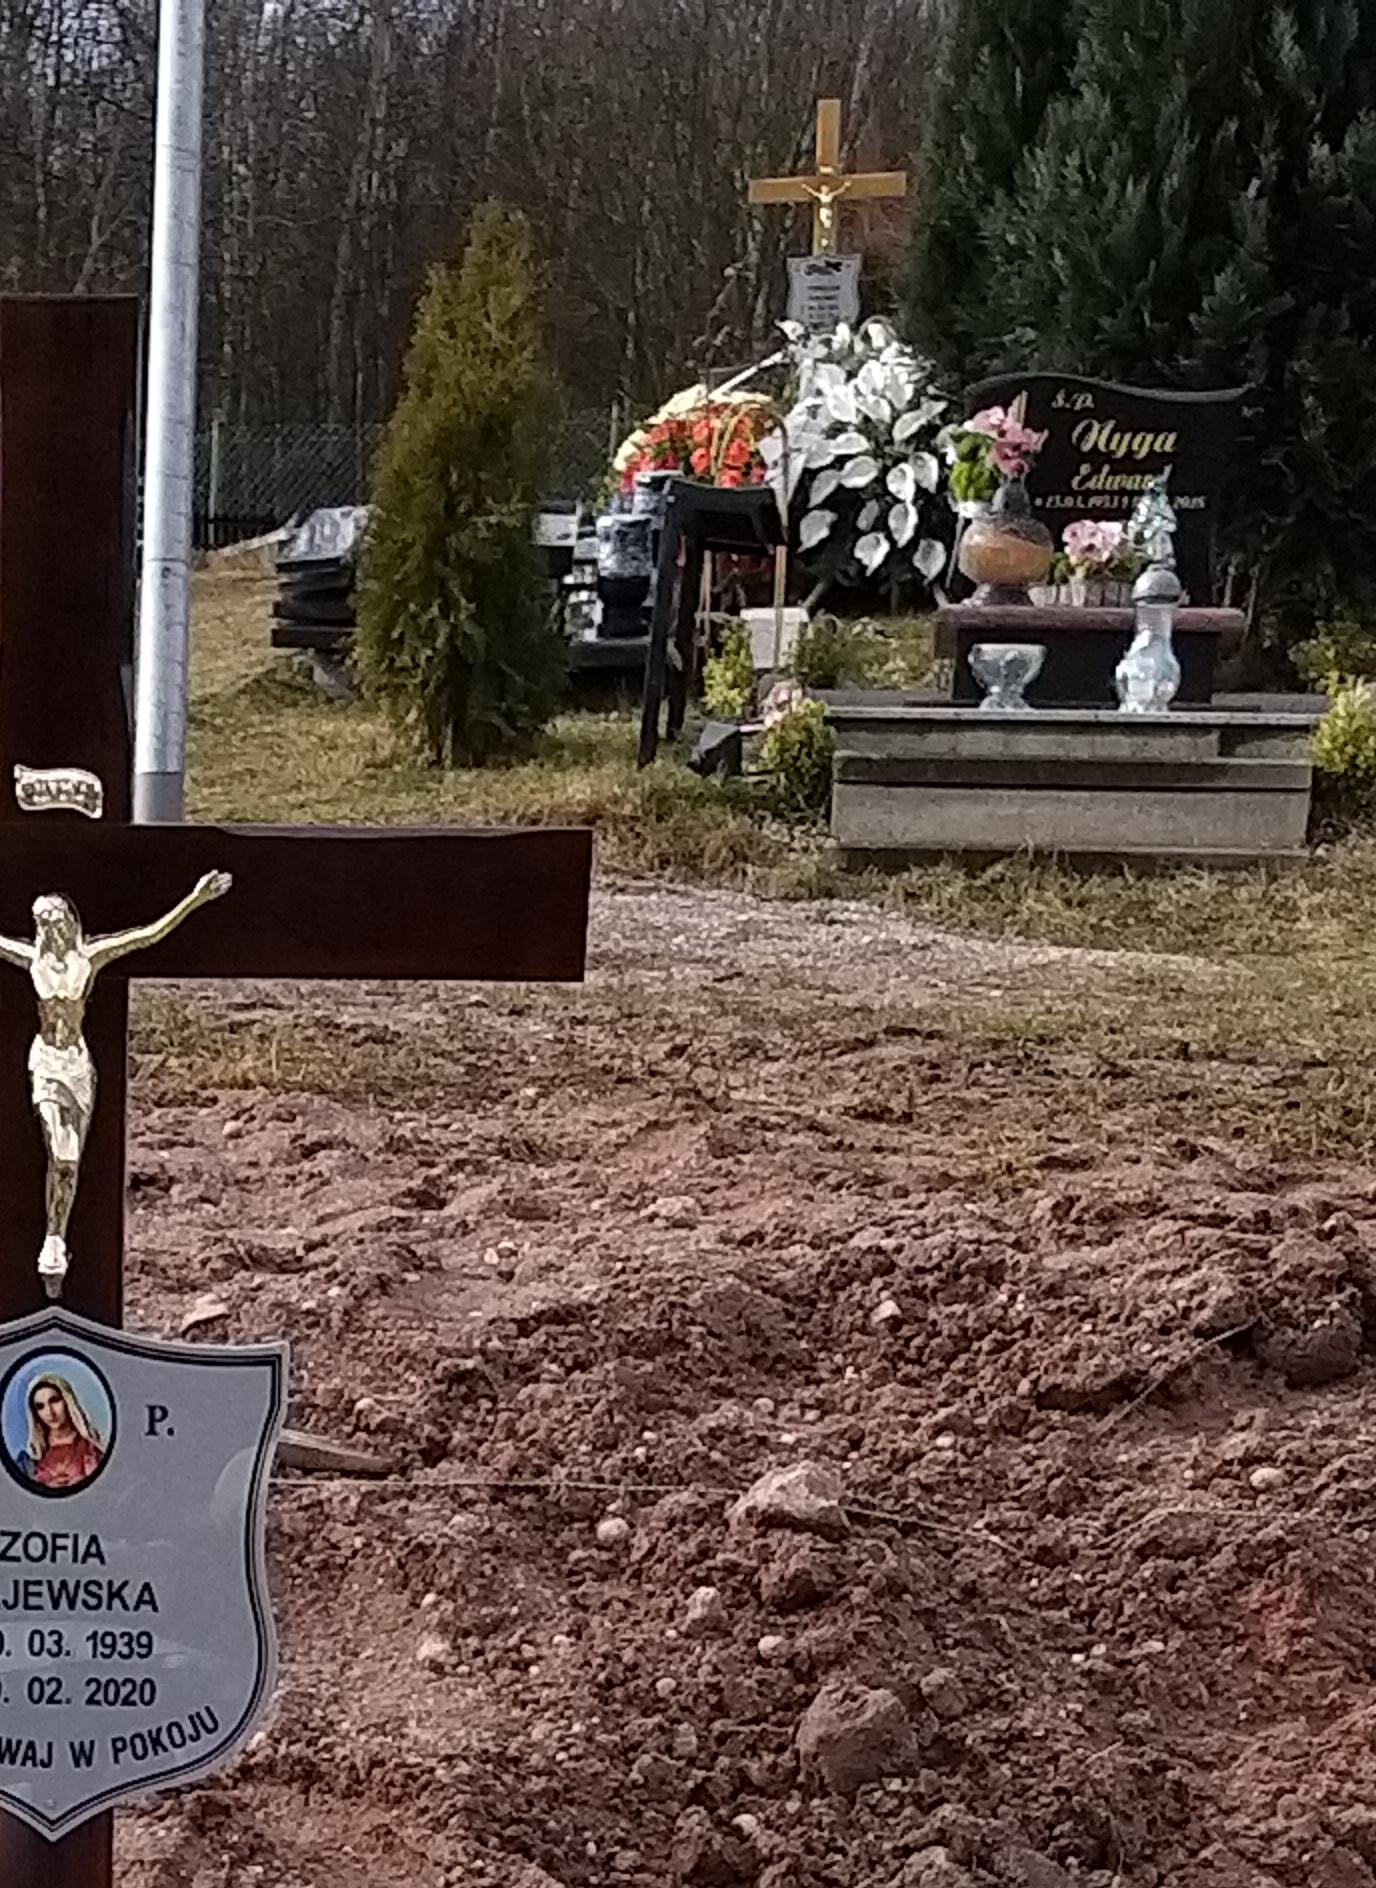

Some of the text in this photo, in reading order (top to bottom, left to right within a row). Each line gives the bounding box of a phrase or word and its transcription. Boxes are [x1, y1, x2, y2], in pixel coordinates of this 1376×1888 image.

[1071, 418, 1178, 459] Nyga
[144, 1404, 176, 1437] P.
[27, 1628, 72, 1659] 03.
[85, 1629, 155, 1660] 1939
[27, 1676, 73, 1706] 02.
[84, 1677, 157, 1708] 2020
[69, 1739, 97, 1769] W
[111, 1703, 221, 1765] POKOJU
